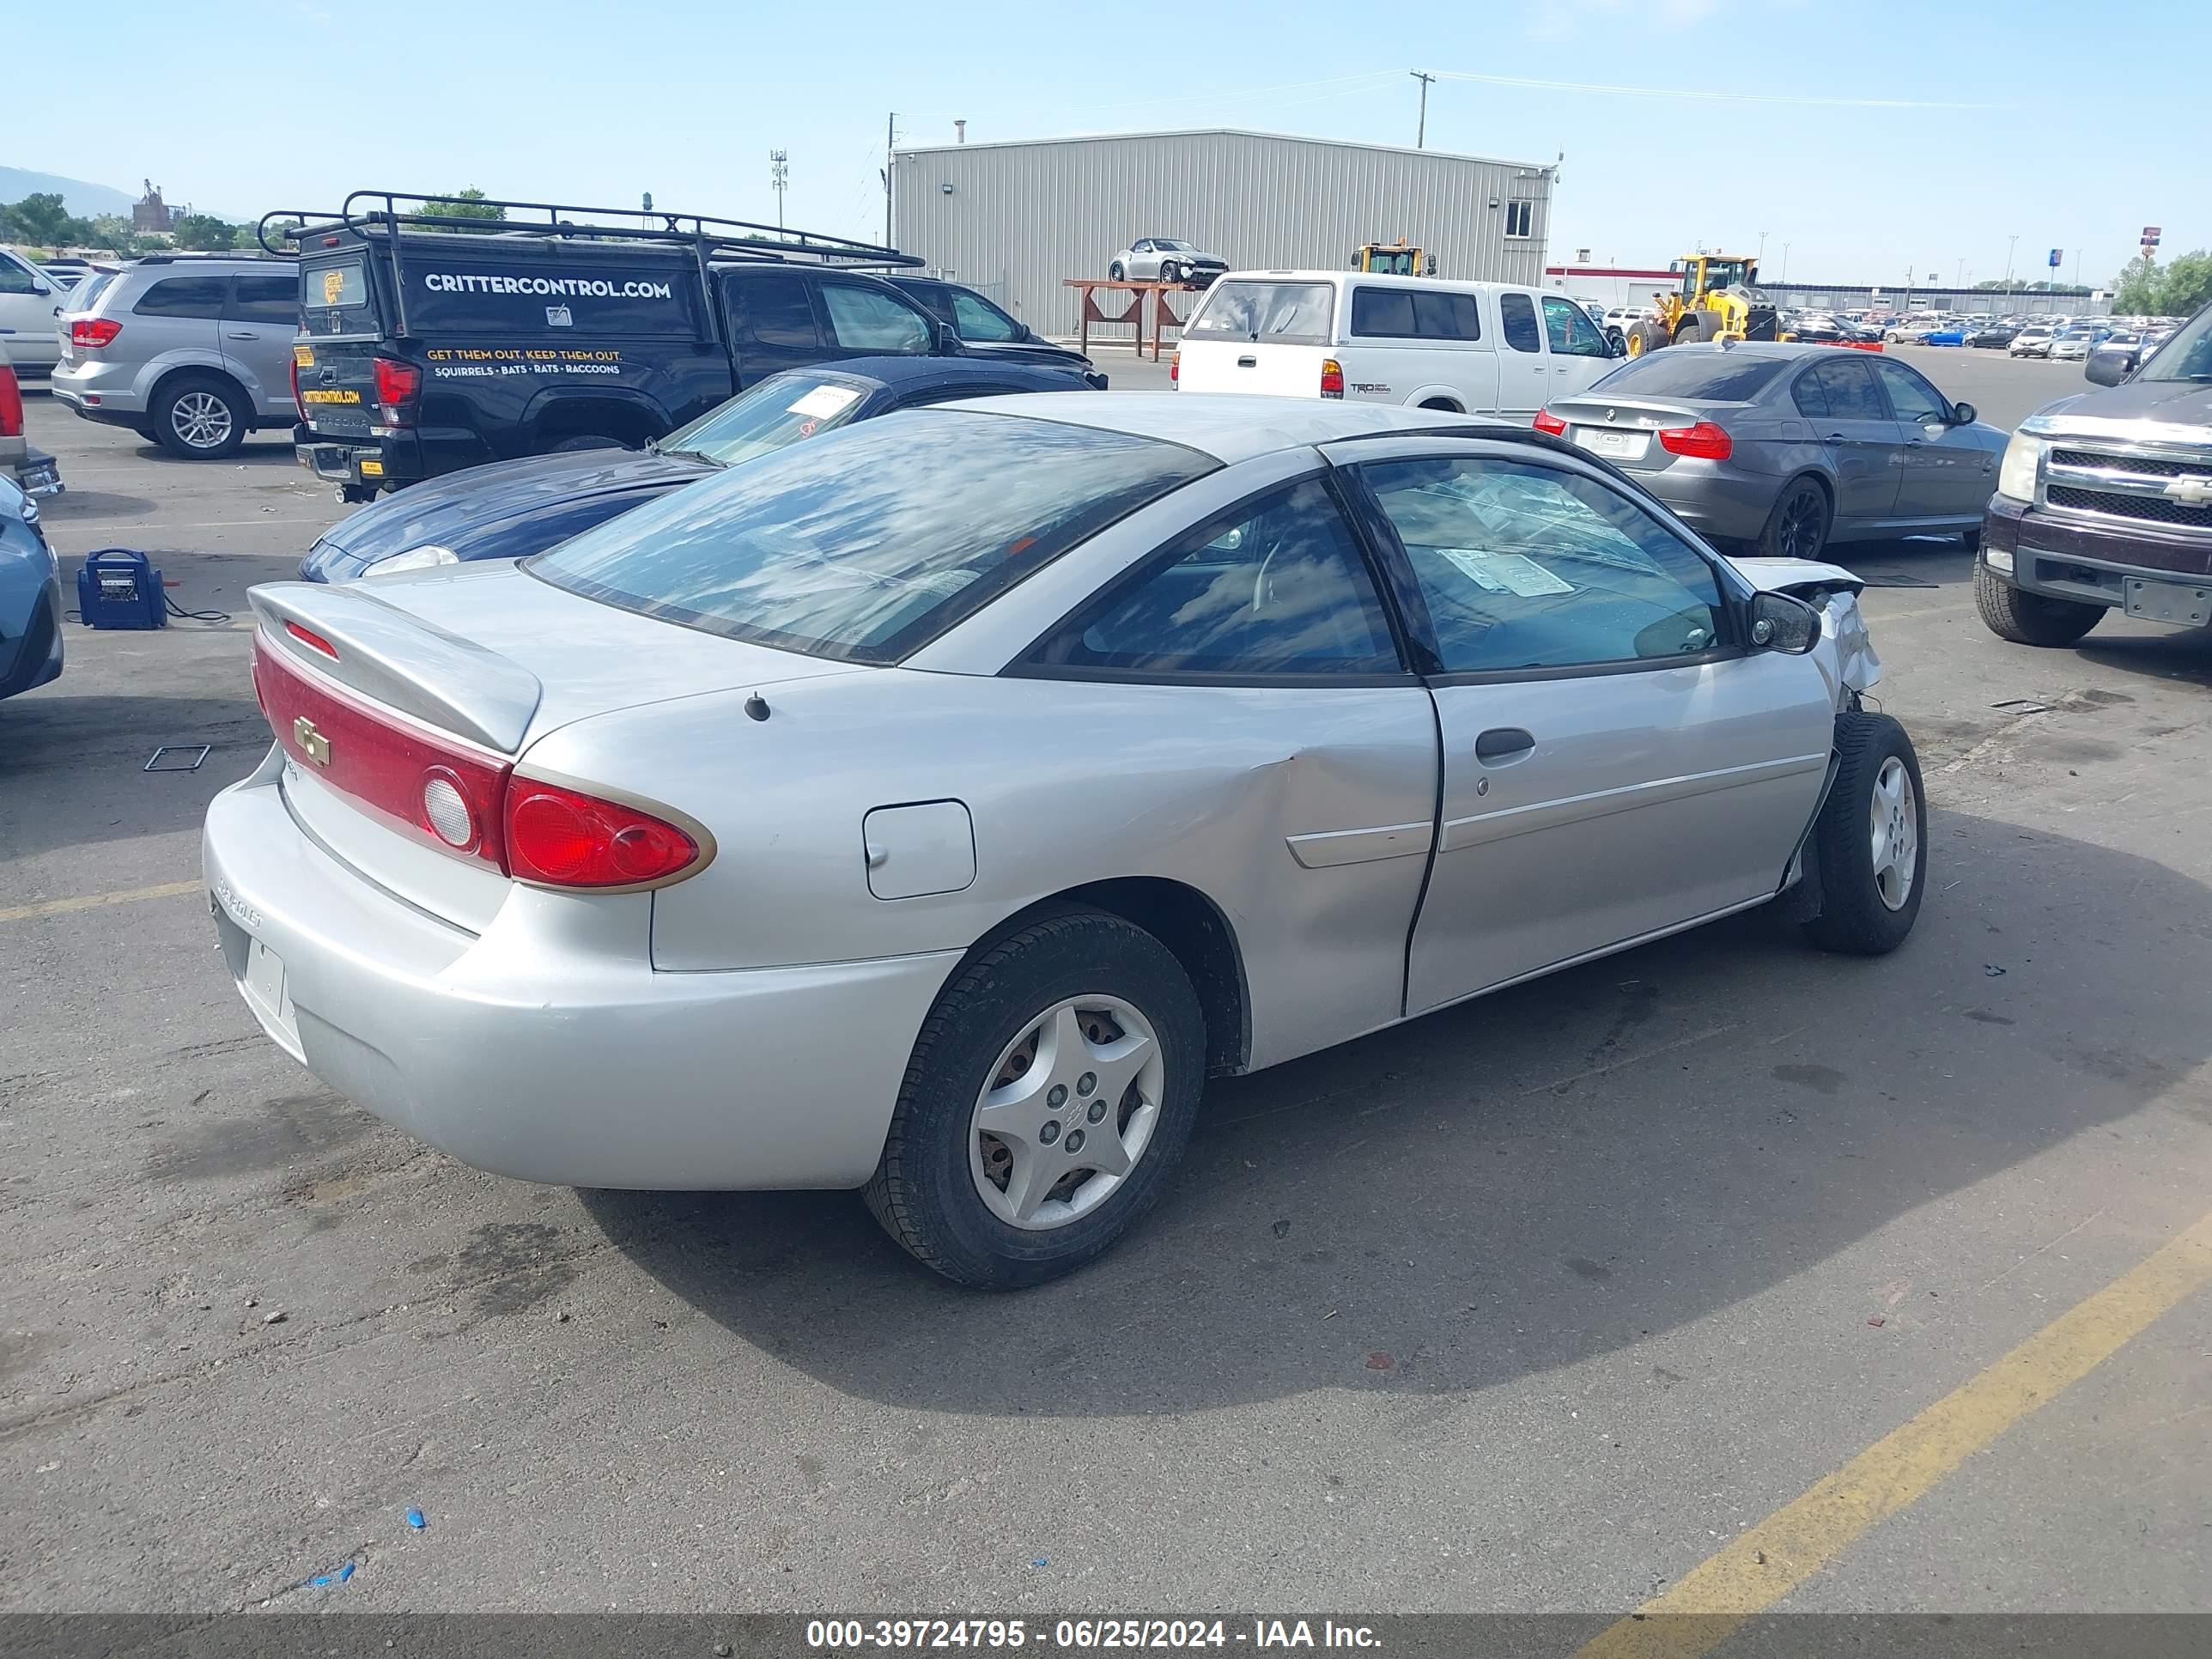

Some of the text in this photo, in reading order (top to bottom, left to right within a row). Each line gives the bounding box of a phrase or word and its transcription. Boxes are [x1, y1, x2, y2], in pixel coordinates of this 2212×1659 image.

[424, 274, 672, 299] CRITTERCONTROL.COM
[427, 349, 623, 362] GET THEM OUT, KEEP THEM OUT.
[434, 364, 620, 379] SQUIRRELS BATS RATS RACCOONS
[302, 390, 361, 404] CRITTERCONTROL.COM
